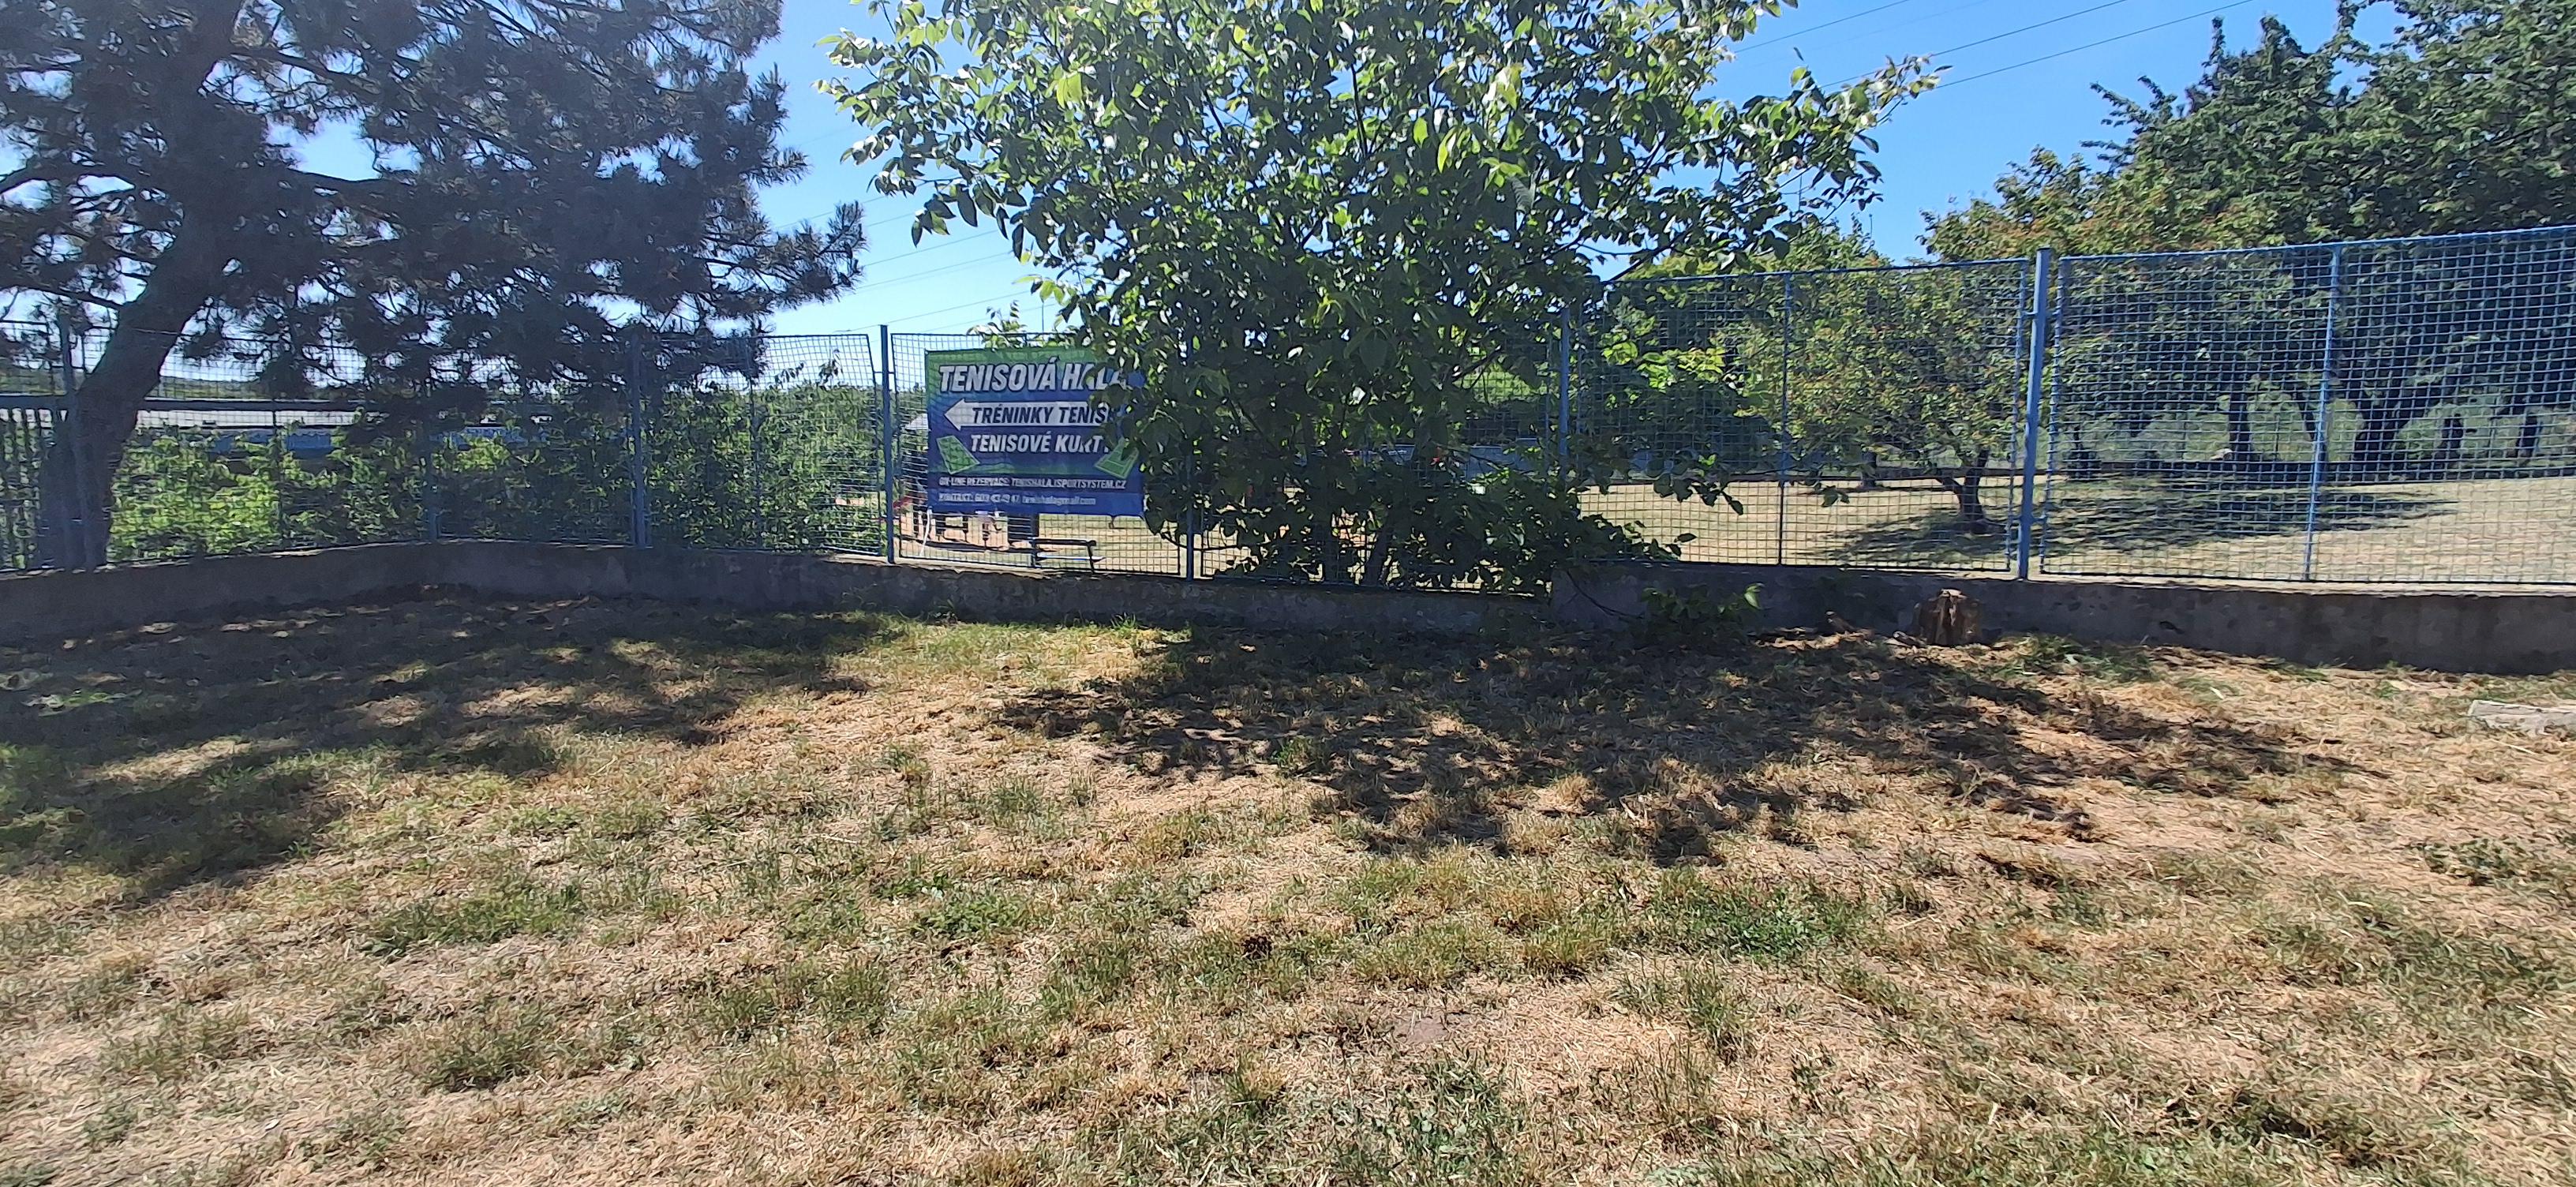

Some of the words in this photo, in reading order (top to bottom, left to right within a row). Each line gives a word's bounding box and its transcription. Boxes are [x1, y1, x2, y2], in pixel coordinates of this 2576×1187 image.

[939, 356, 1059, 392] TENISOVÁ
[972, 403, 1053, 424] TRÉNINKY
[1059, 406, 1112, 424] TENIS
[971, 431, 1051, 452] TENISOVÉ
[1054, 434, 1109, 453] KURT
